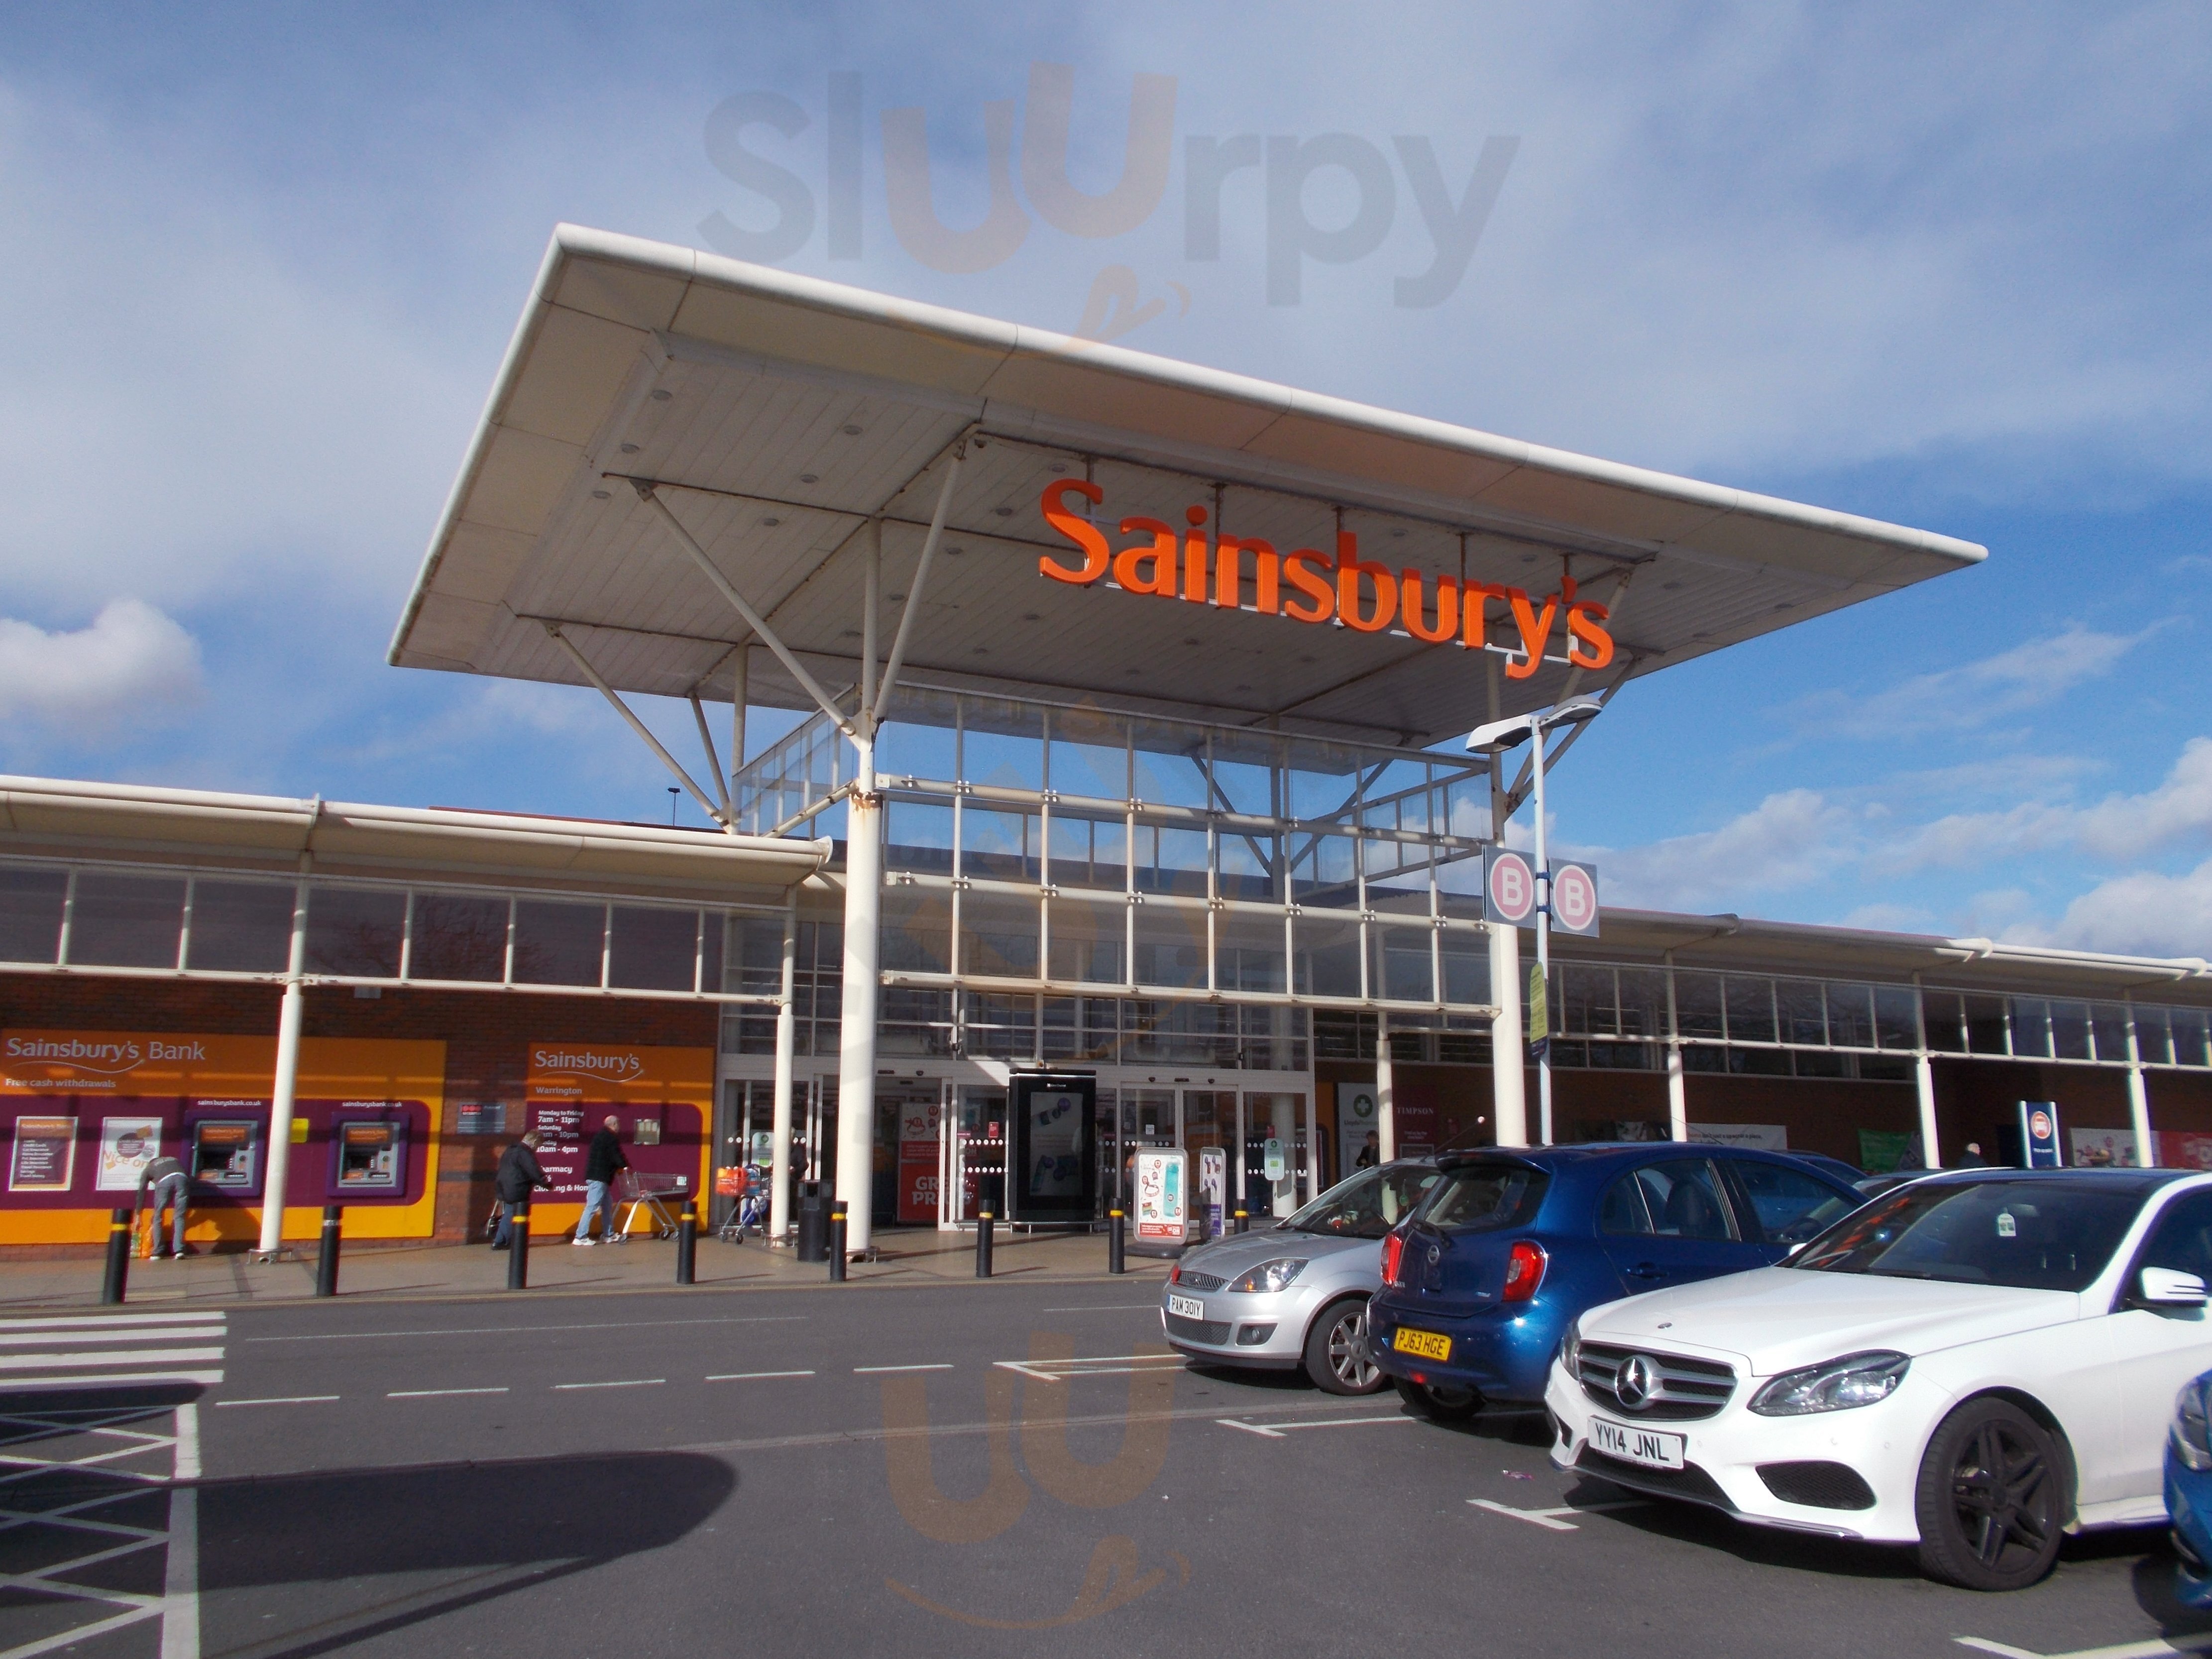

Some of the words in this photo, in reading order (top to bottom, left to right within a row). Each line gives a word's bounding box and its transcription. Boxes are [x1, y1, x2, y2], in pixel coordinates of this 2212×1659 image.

[1040, 478, 1615, 680] Sainsbury's
[1501, 866, 1524, 906] B
[1564, 878, 1586, 916] B
[6, 1037, 139, 1063] Sainsbury's
[149, 1041, 206, 1060] Bank
[535, 1050, 640, 1073] Sainsbury's
[5, 1078, 27, 1087] Free
[30, 1078, 52, 1087] cash
[55, 1079, 116, 1088] withdrawals
[536, 1087, 582, 1096] Warrington
[1397, 1106, 1434, 1115] TIMPSON
[1172, 1297, 1184, 1313] PAM
[1185, 1300, 1201, 1317] 301Y
[1398, 1330, 1423, 1350] PJ63
[1423, 1336, 1446, 1356] HGE
[1595, 1422, 1627, 1453] YY14
[1632, 1434, 1670, 1462] JNL
